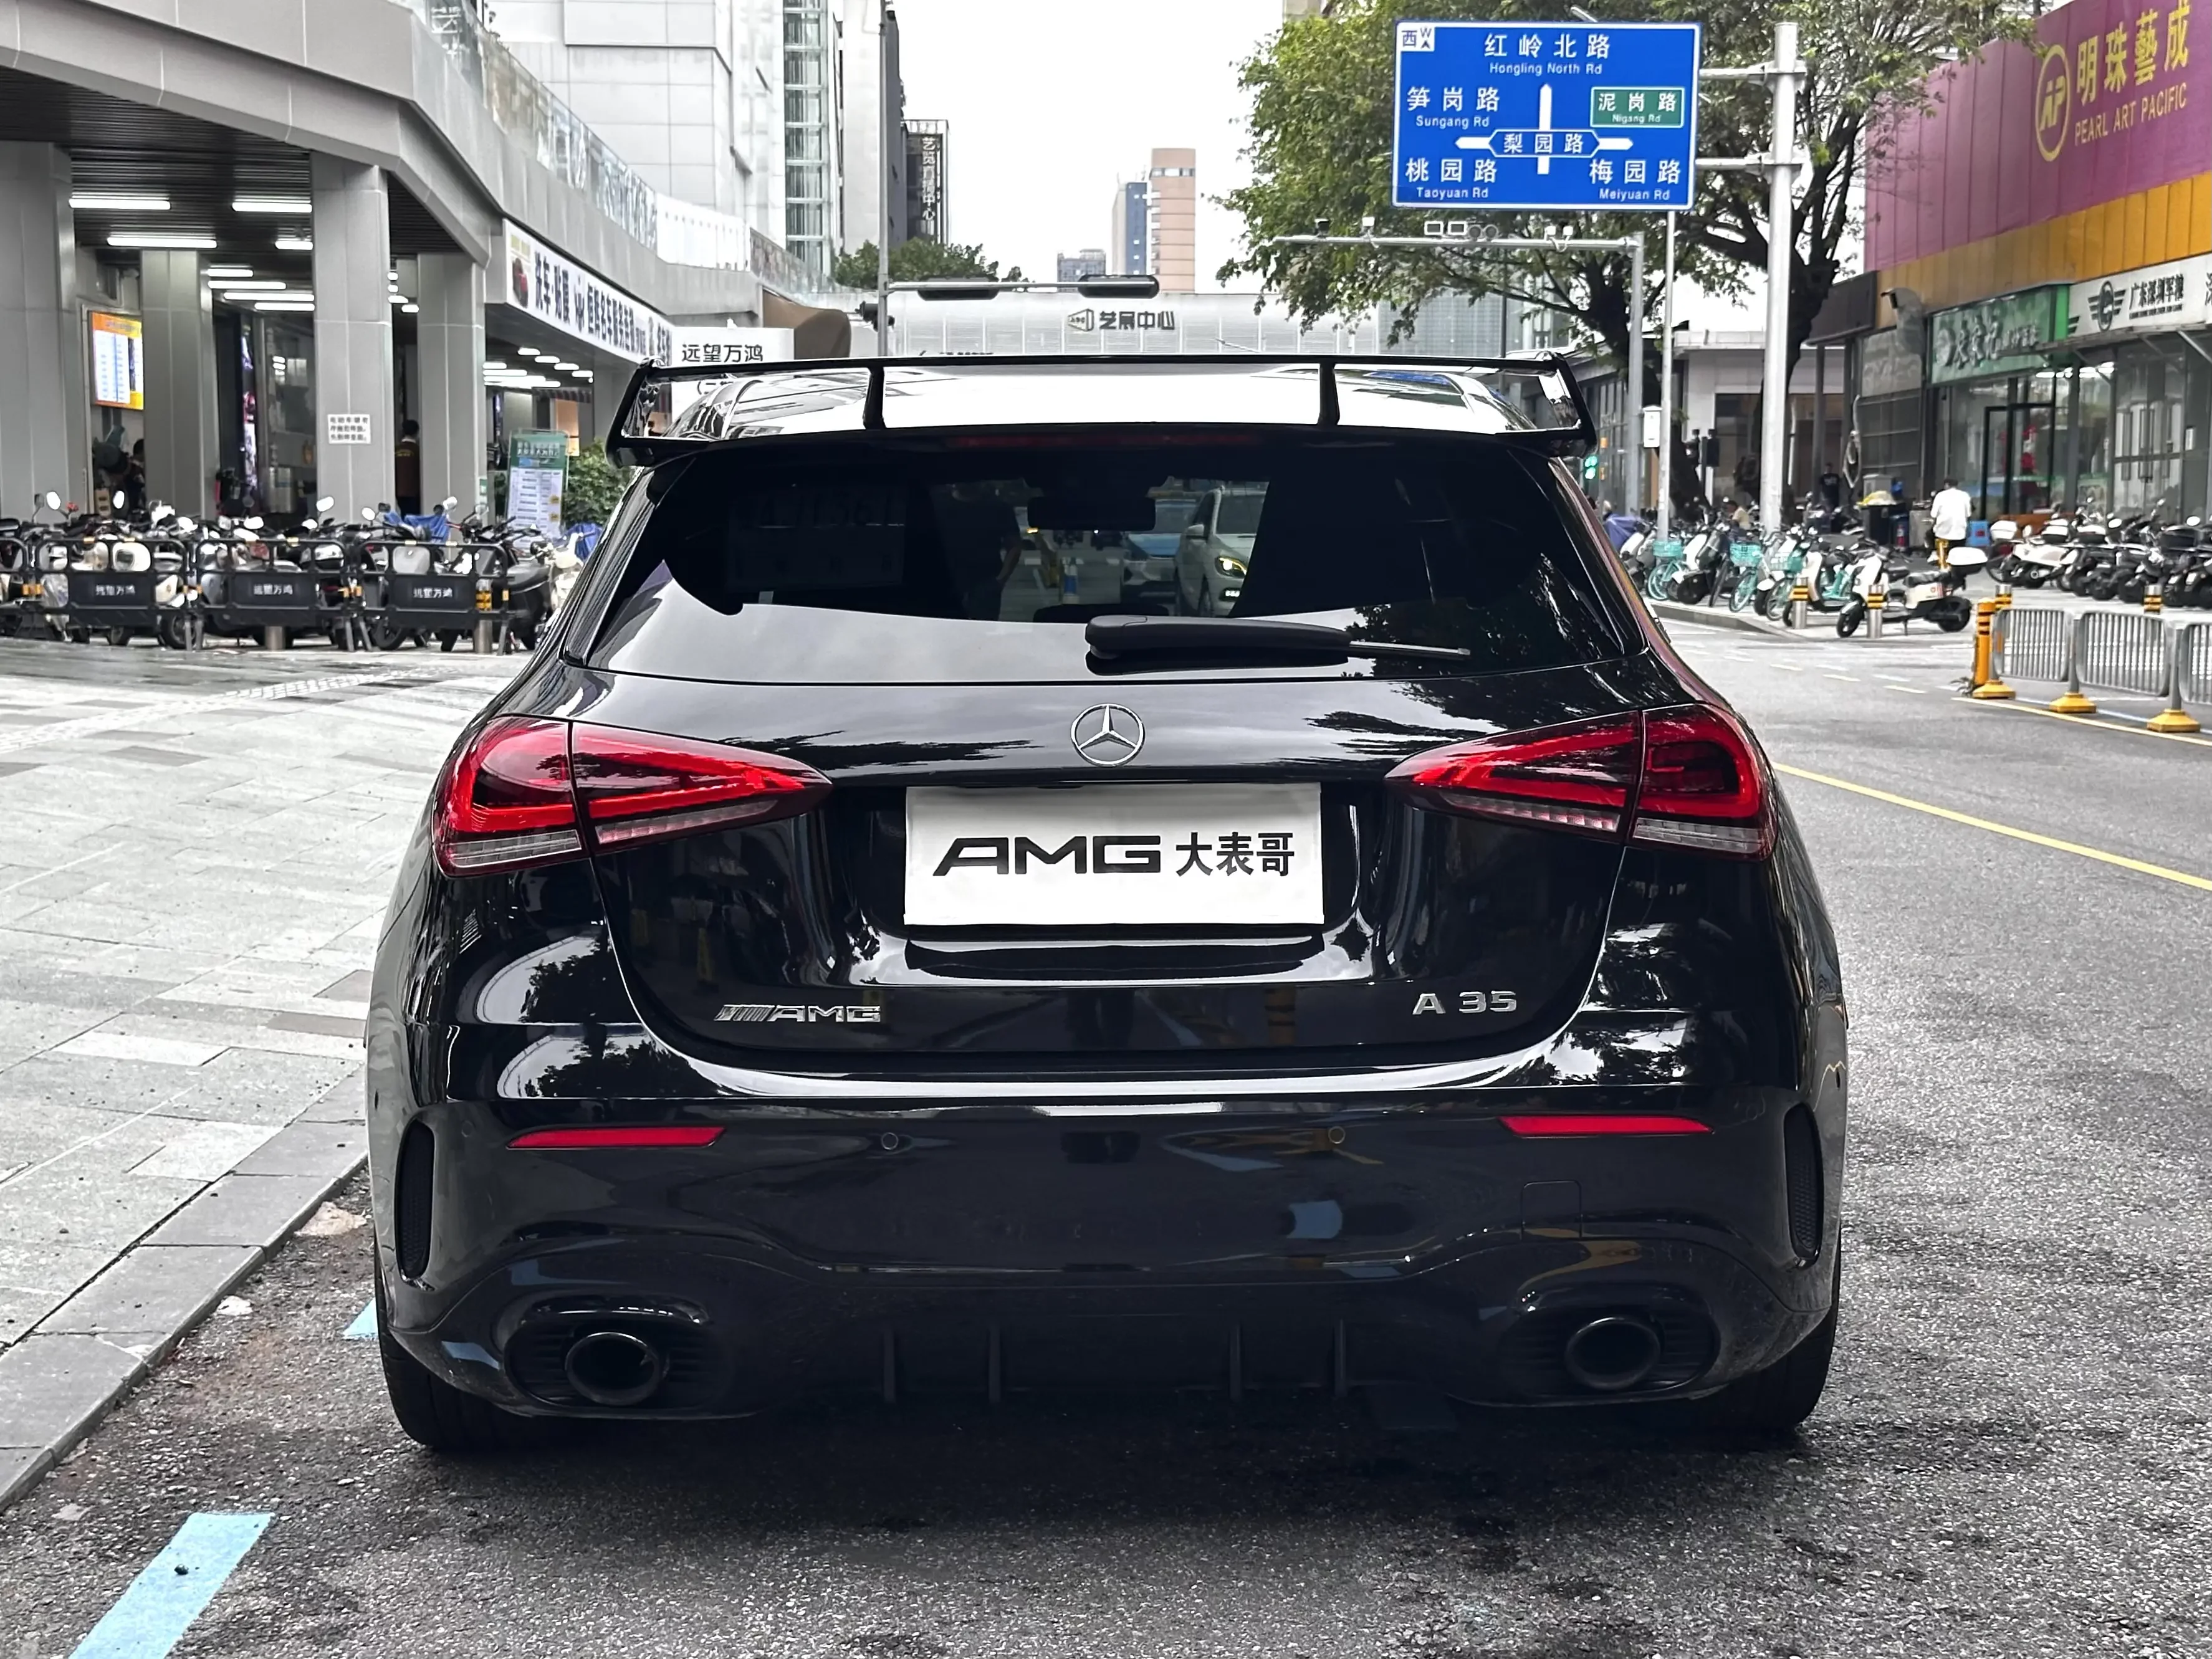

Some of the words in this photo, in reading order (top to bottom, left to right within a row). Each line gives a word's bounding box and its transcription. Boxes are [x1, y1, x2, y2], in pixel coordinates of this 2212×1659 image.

[1402, 30, 1417, 47] 西
[1420, 27, 1432, 38] W
[1484, 33, 1610, 59] 红岭北路
[2076, 0, 2190, 107] 明珠藝成
[1490, 62, 1543, 76] Hongling
[1547, 62, 1580, 74] North
[1586, 64, 1602, 75] Rd
[1407, 86, 1500, 112] 笋岗路
[1598, 92, 1677, 112] 泥岗路
[1415, 115, 1469, 129] Sungang
[1473, 116, 1490, 127] Rd
[1612, 114, 1645, 124] Nigang
[1648, 114, 1662, 123] Rd
[2075, 112, 2109, 147] PEARL
[2113, 100, 2137, 132] ART
[2140, 82, 2188, 123] PACIFIC
[1503, 133, 1584, 154] 梨园路
[1405, 157, 1497, 183] 桃园路
[1589, 159, 1681, 184] 梅园路
[1416, 187, 1468, 201] Taoyuan
[1472, 188, 1489, 198] Rd
[1599, 188, 1650, 202] Meiyuan
[1654, 189, 1670, 201] Rd
[1099, 311, 1175, 330] 艺展中心
[681, 343, 764, 363] 远望万鸿
[933, 836, 1161, 876] AMG
[1175, 831, 1295, 876] 大表哥
[1412, 993, 1446, 1015] A
[1459, 990, 1517, 1013] 35
[767, 1005, 881, 1023] AMG
